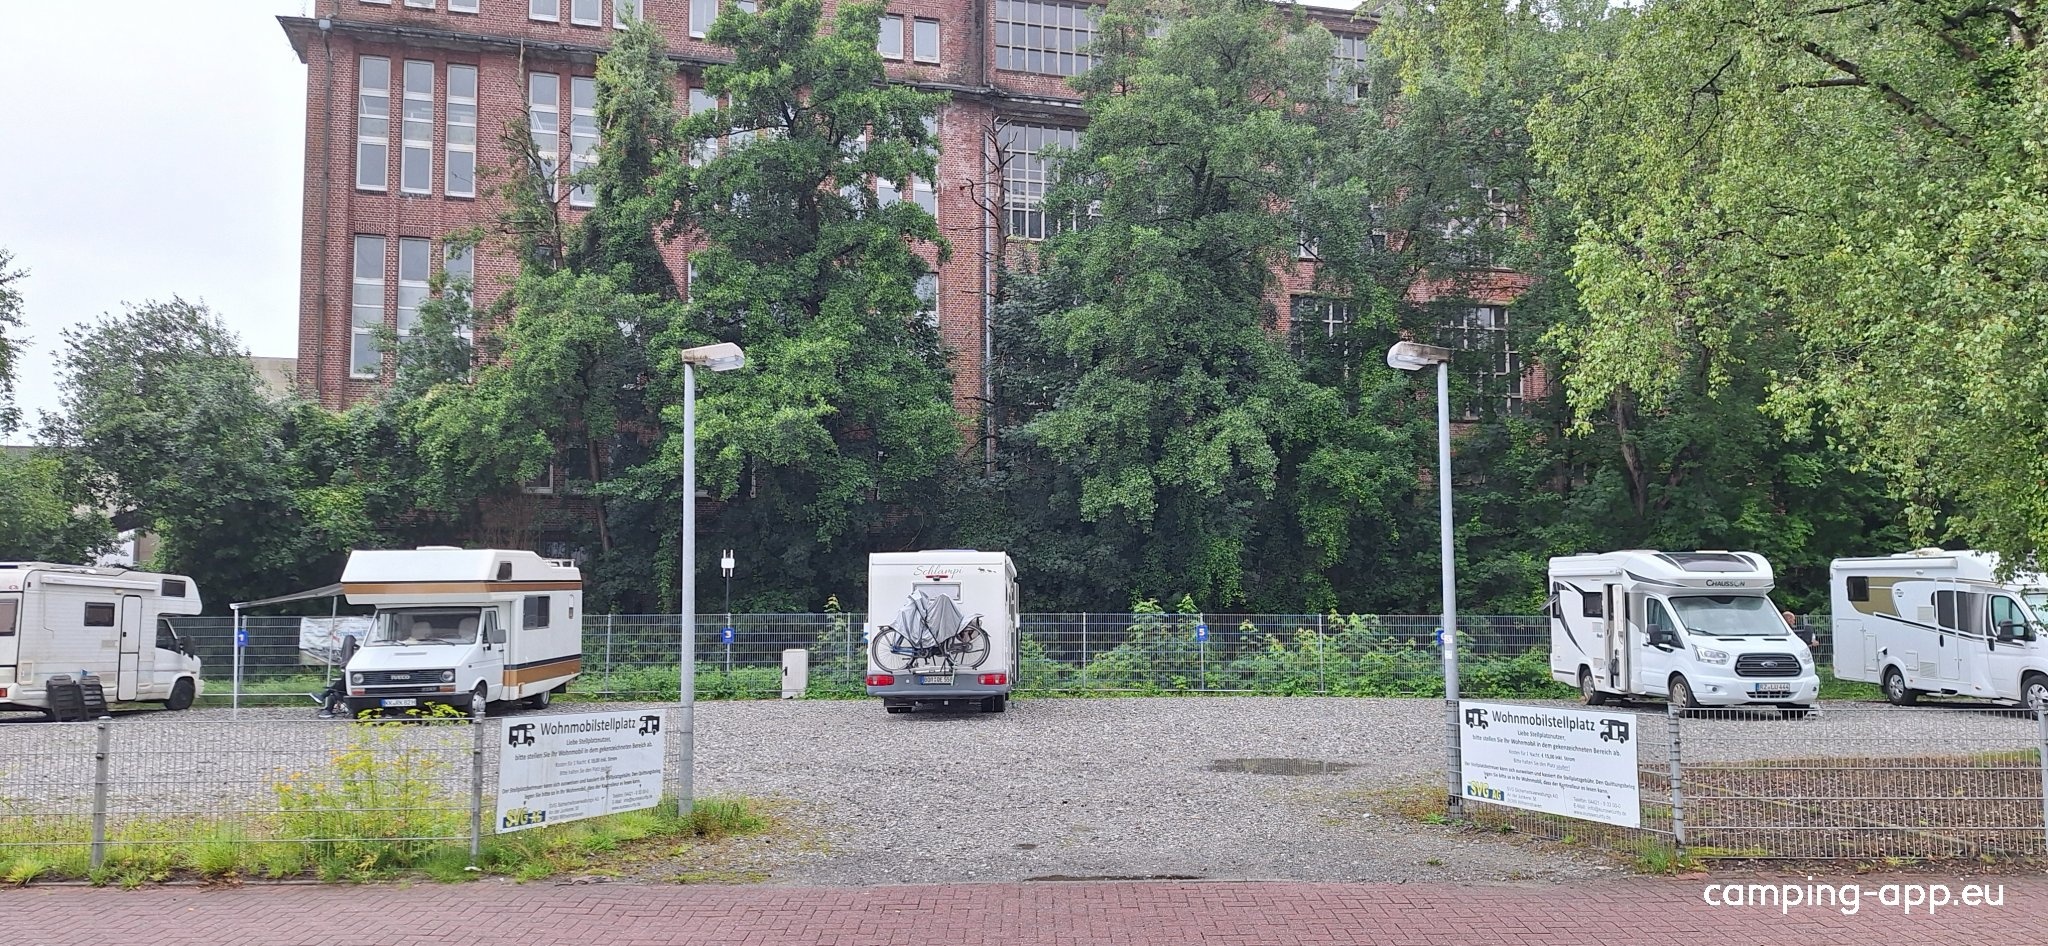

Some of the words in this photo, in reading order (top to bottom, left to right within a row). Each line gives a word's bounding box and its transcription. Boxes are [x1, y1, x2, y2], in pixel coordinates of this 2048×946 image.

[914, 565, 962, 578] Schlampi
[725, 630, 732, 638] 3
[540, 716, 636, 736] Wohnmobilstellplatz
[1492, 710, 1595, 732] Wohnmobilstellplatz
[1470, 779, 1488, 798] SVG
[1491, 787, 1500, 800] AG
[505, 806, 528, 827] SVG
